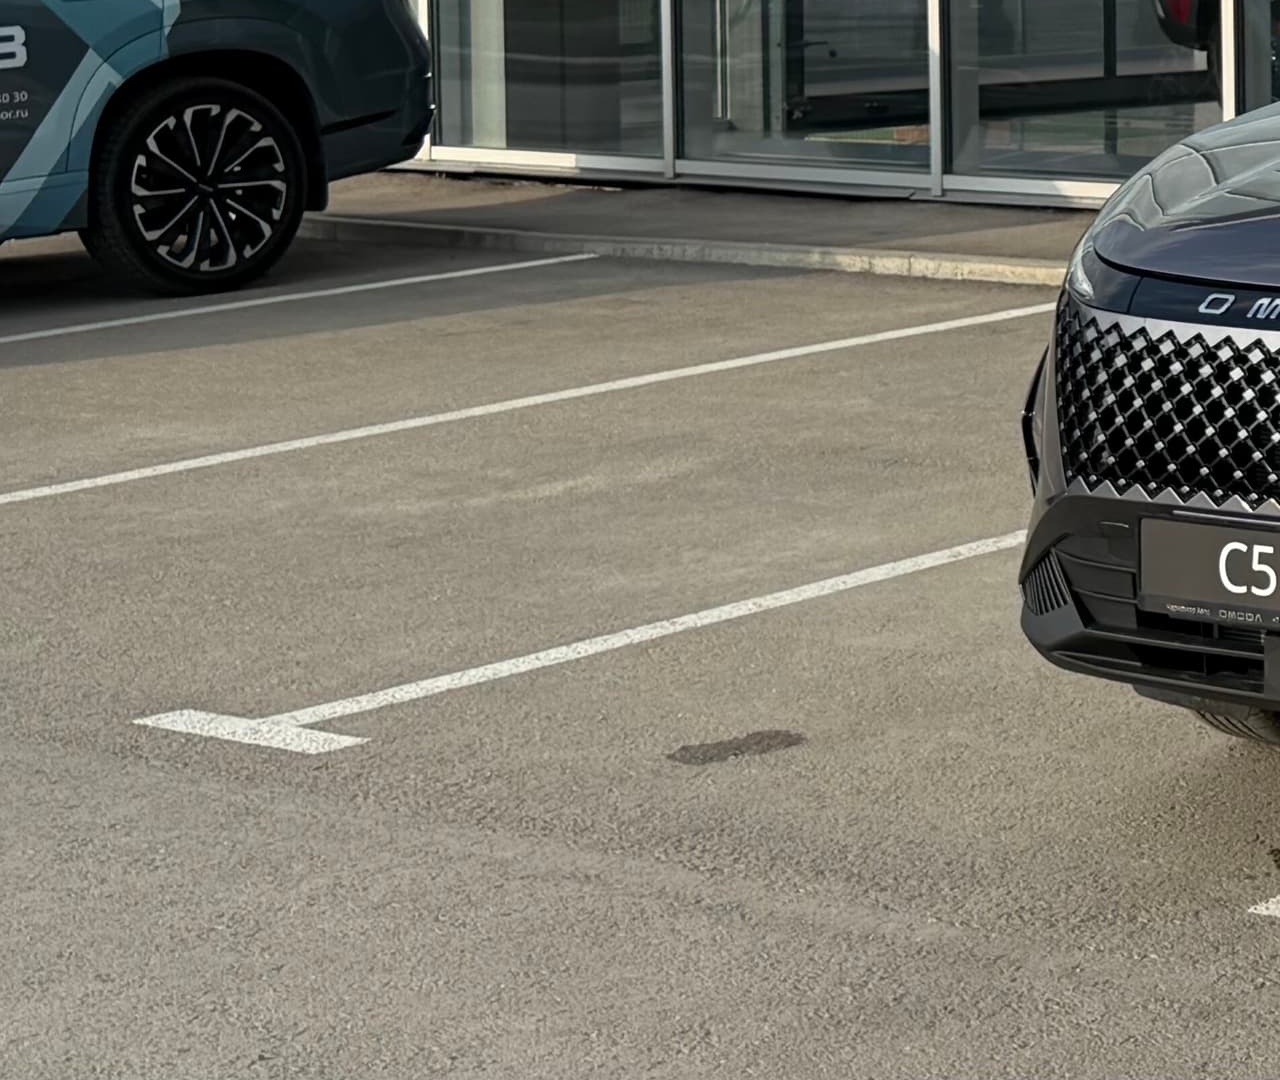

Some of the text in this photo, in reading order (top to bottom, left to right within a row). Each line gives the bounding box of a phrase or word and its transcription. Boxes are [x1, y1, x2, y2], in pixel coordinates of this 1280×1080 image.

[0, 90, 28, 104] 0 30
[1218, 541, 1277, 597] C5
[1218, 609, 1262, 622] OMODA
